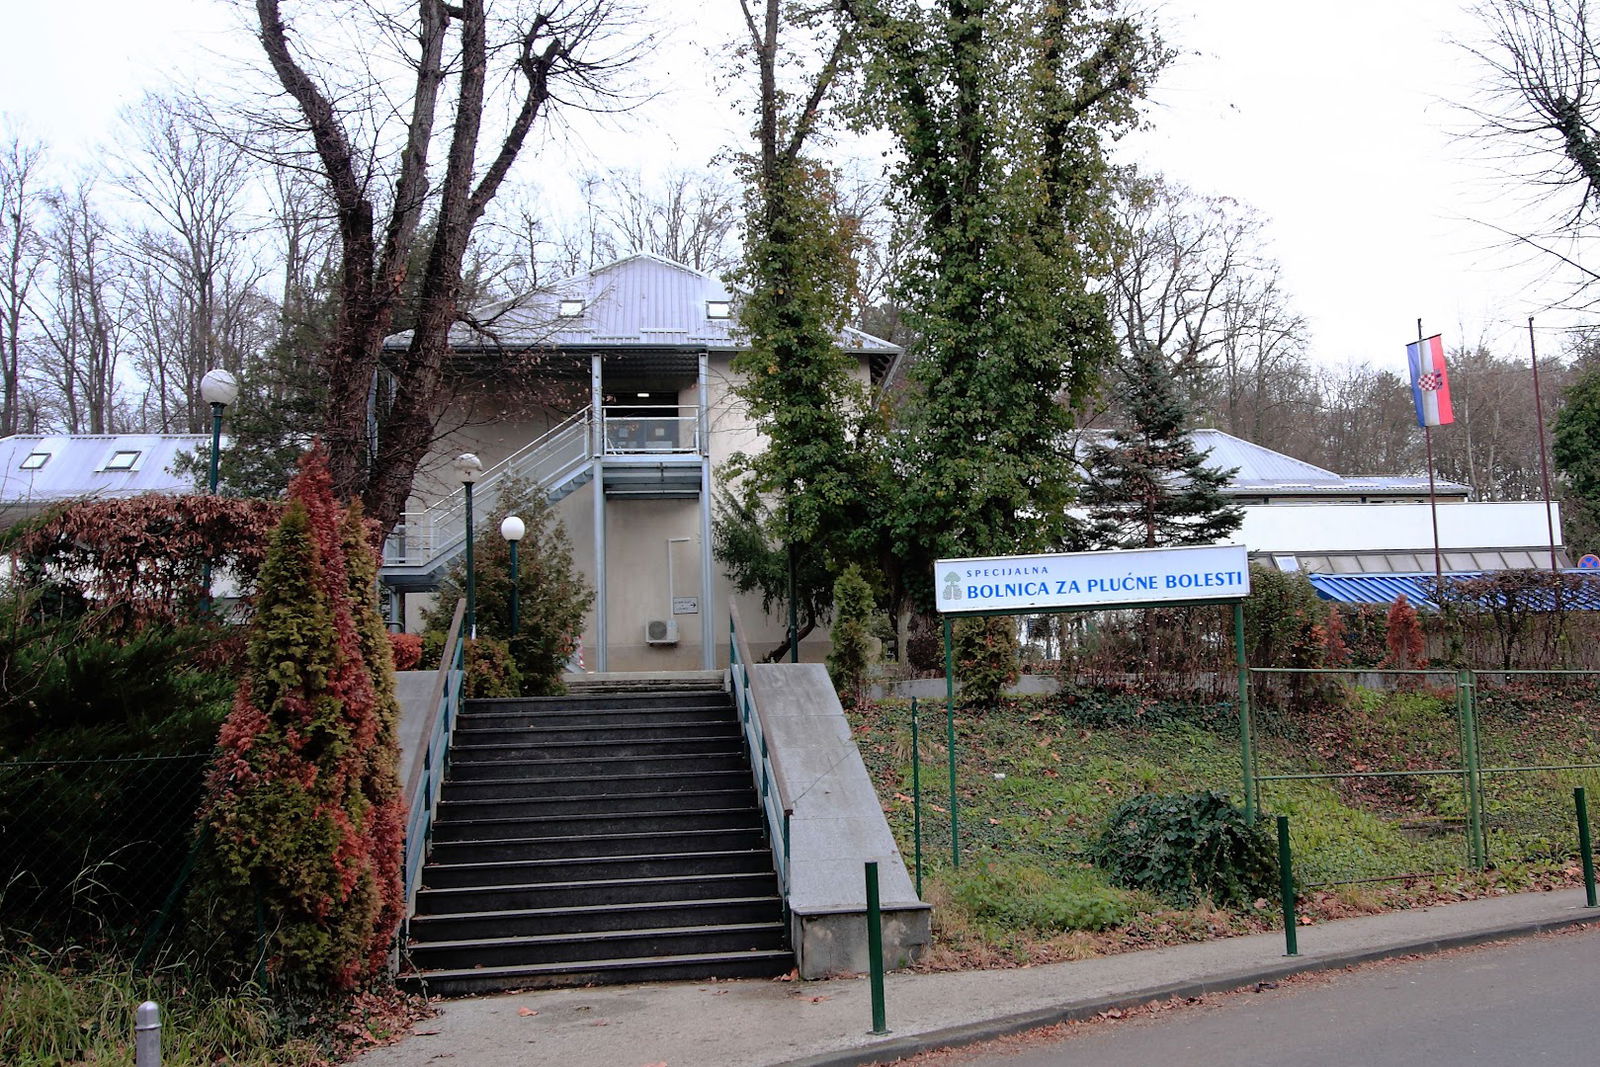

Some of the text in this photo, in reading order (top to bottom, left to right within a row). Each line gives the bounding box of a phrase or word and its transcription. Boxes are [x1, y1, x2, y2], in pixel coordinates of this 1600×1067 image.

[967, 566, 1049, 577] SPECIJALNA
[967, 571, 1243, 599] BOLNICA ZA PLUĆNE BOLESTI
